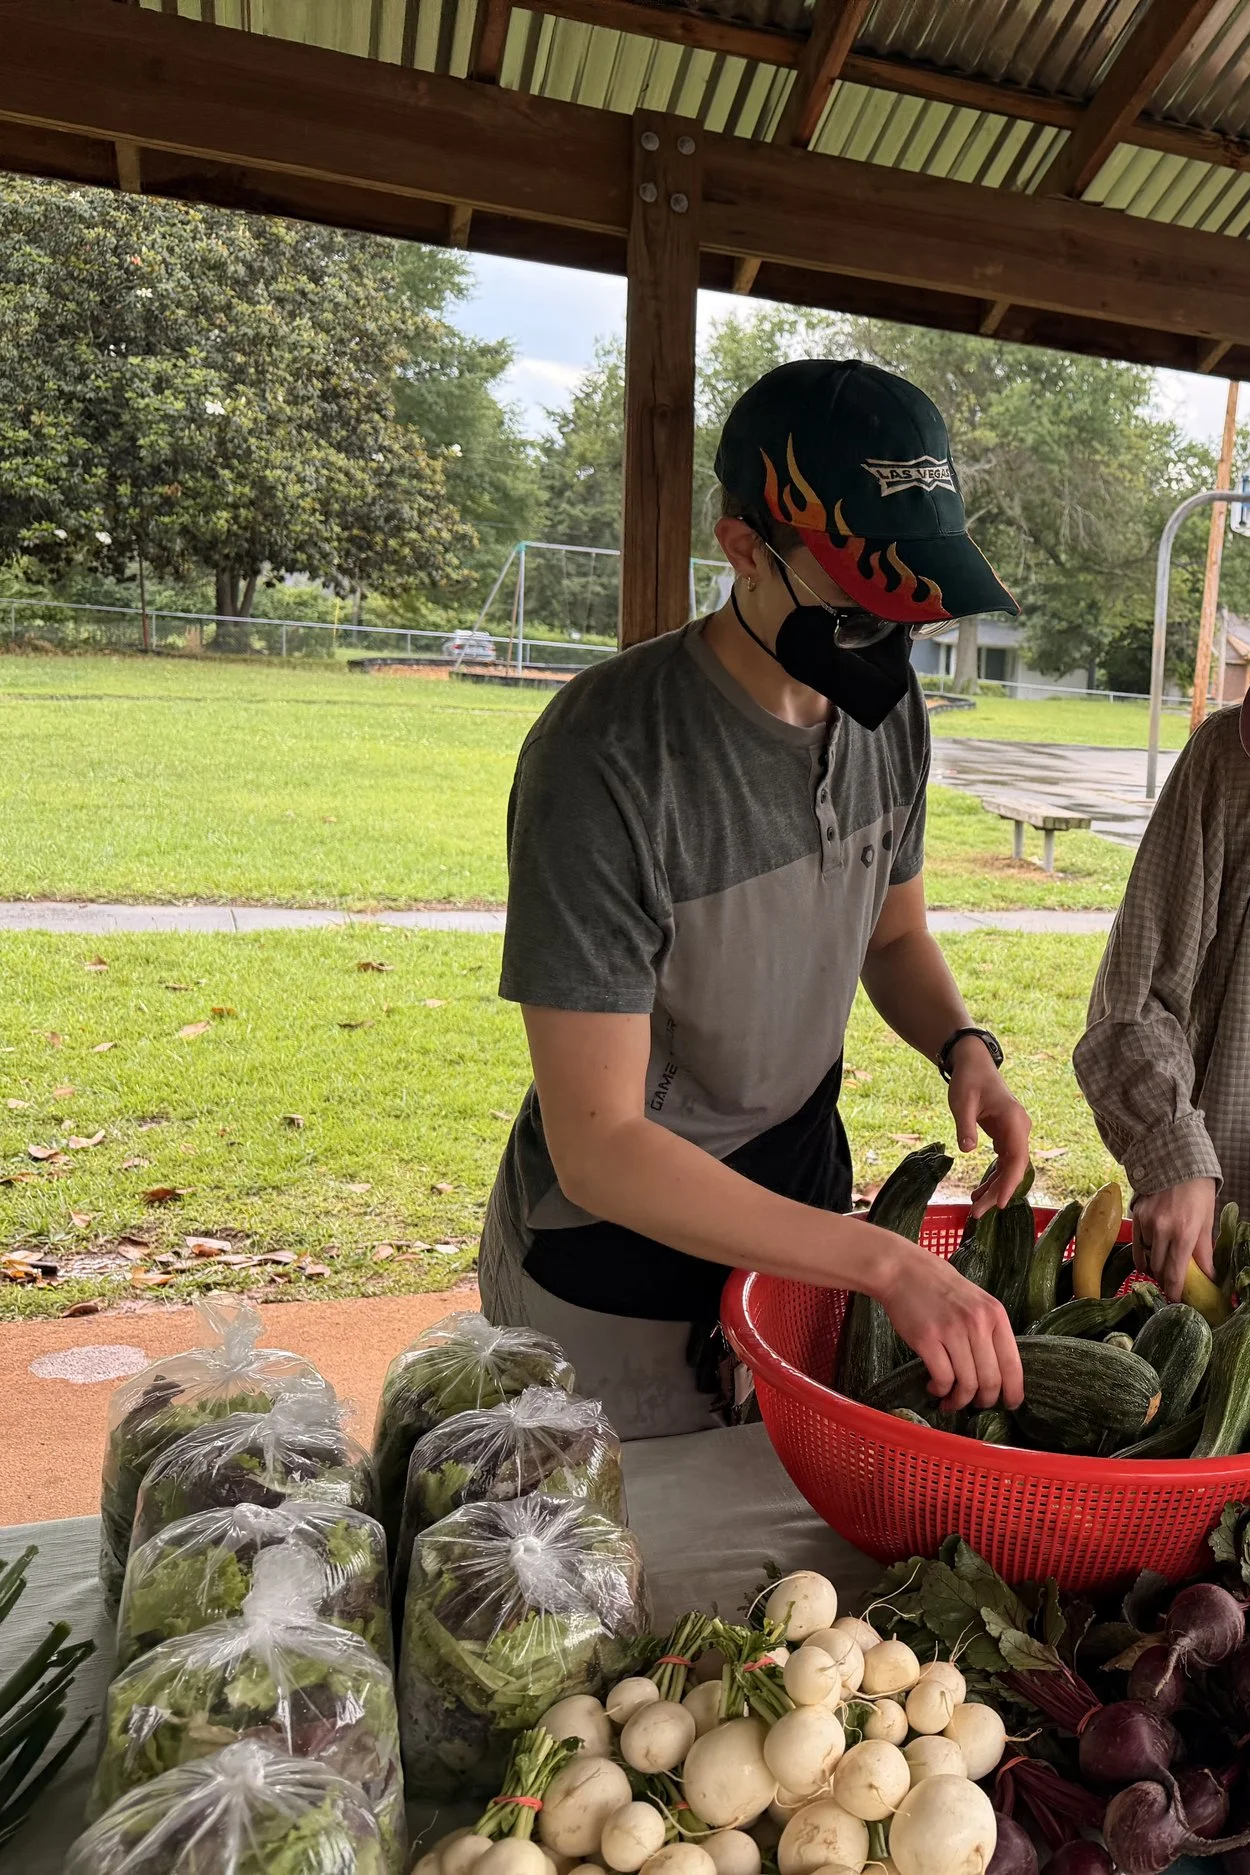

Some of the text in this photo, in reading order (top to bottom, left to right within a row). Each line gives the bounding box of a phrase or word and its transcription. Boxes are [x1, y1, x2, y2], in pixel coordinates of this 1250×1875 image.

[876, 468, 950, 479] LAS VEGAS
[650, 1062, 678, 1112] GAME
